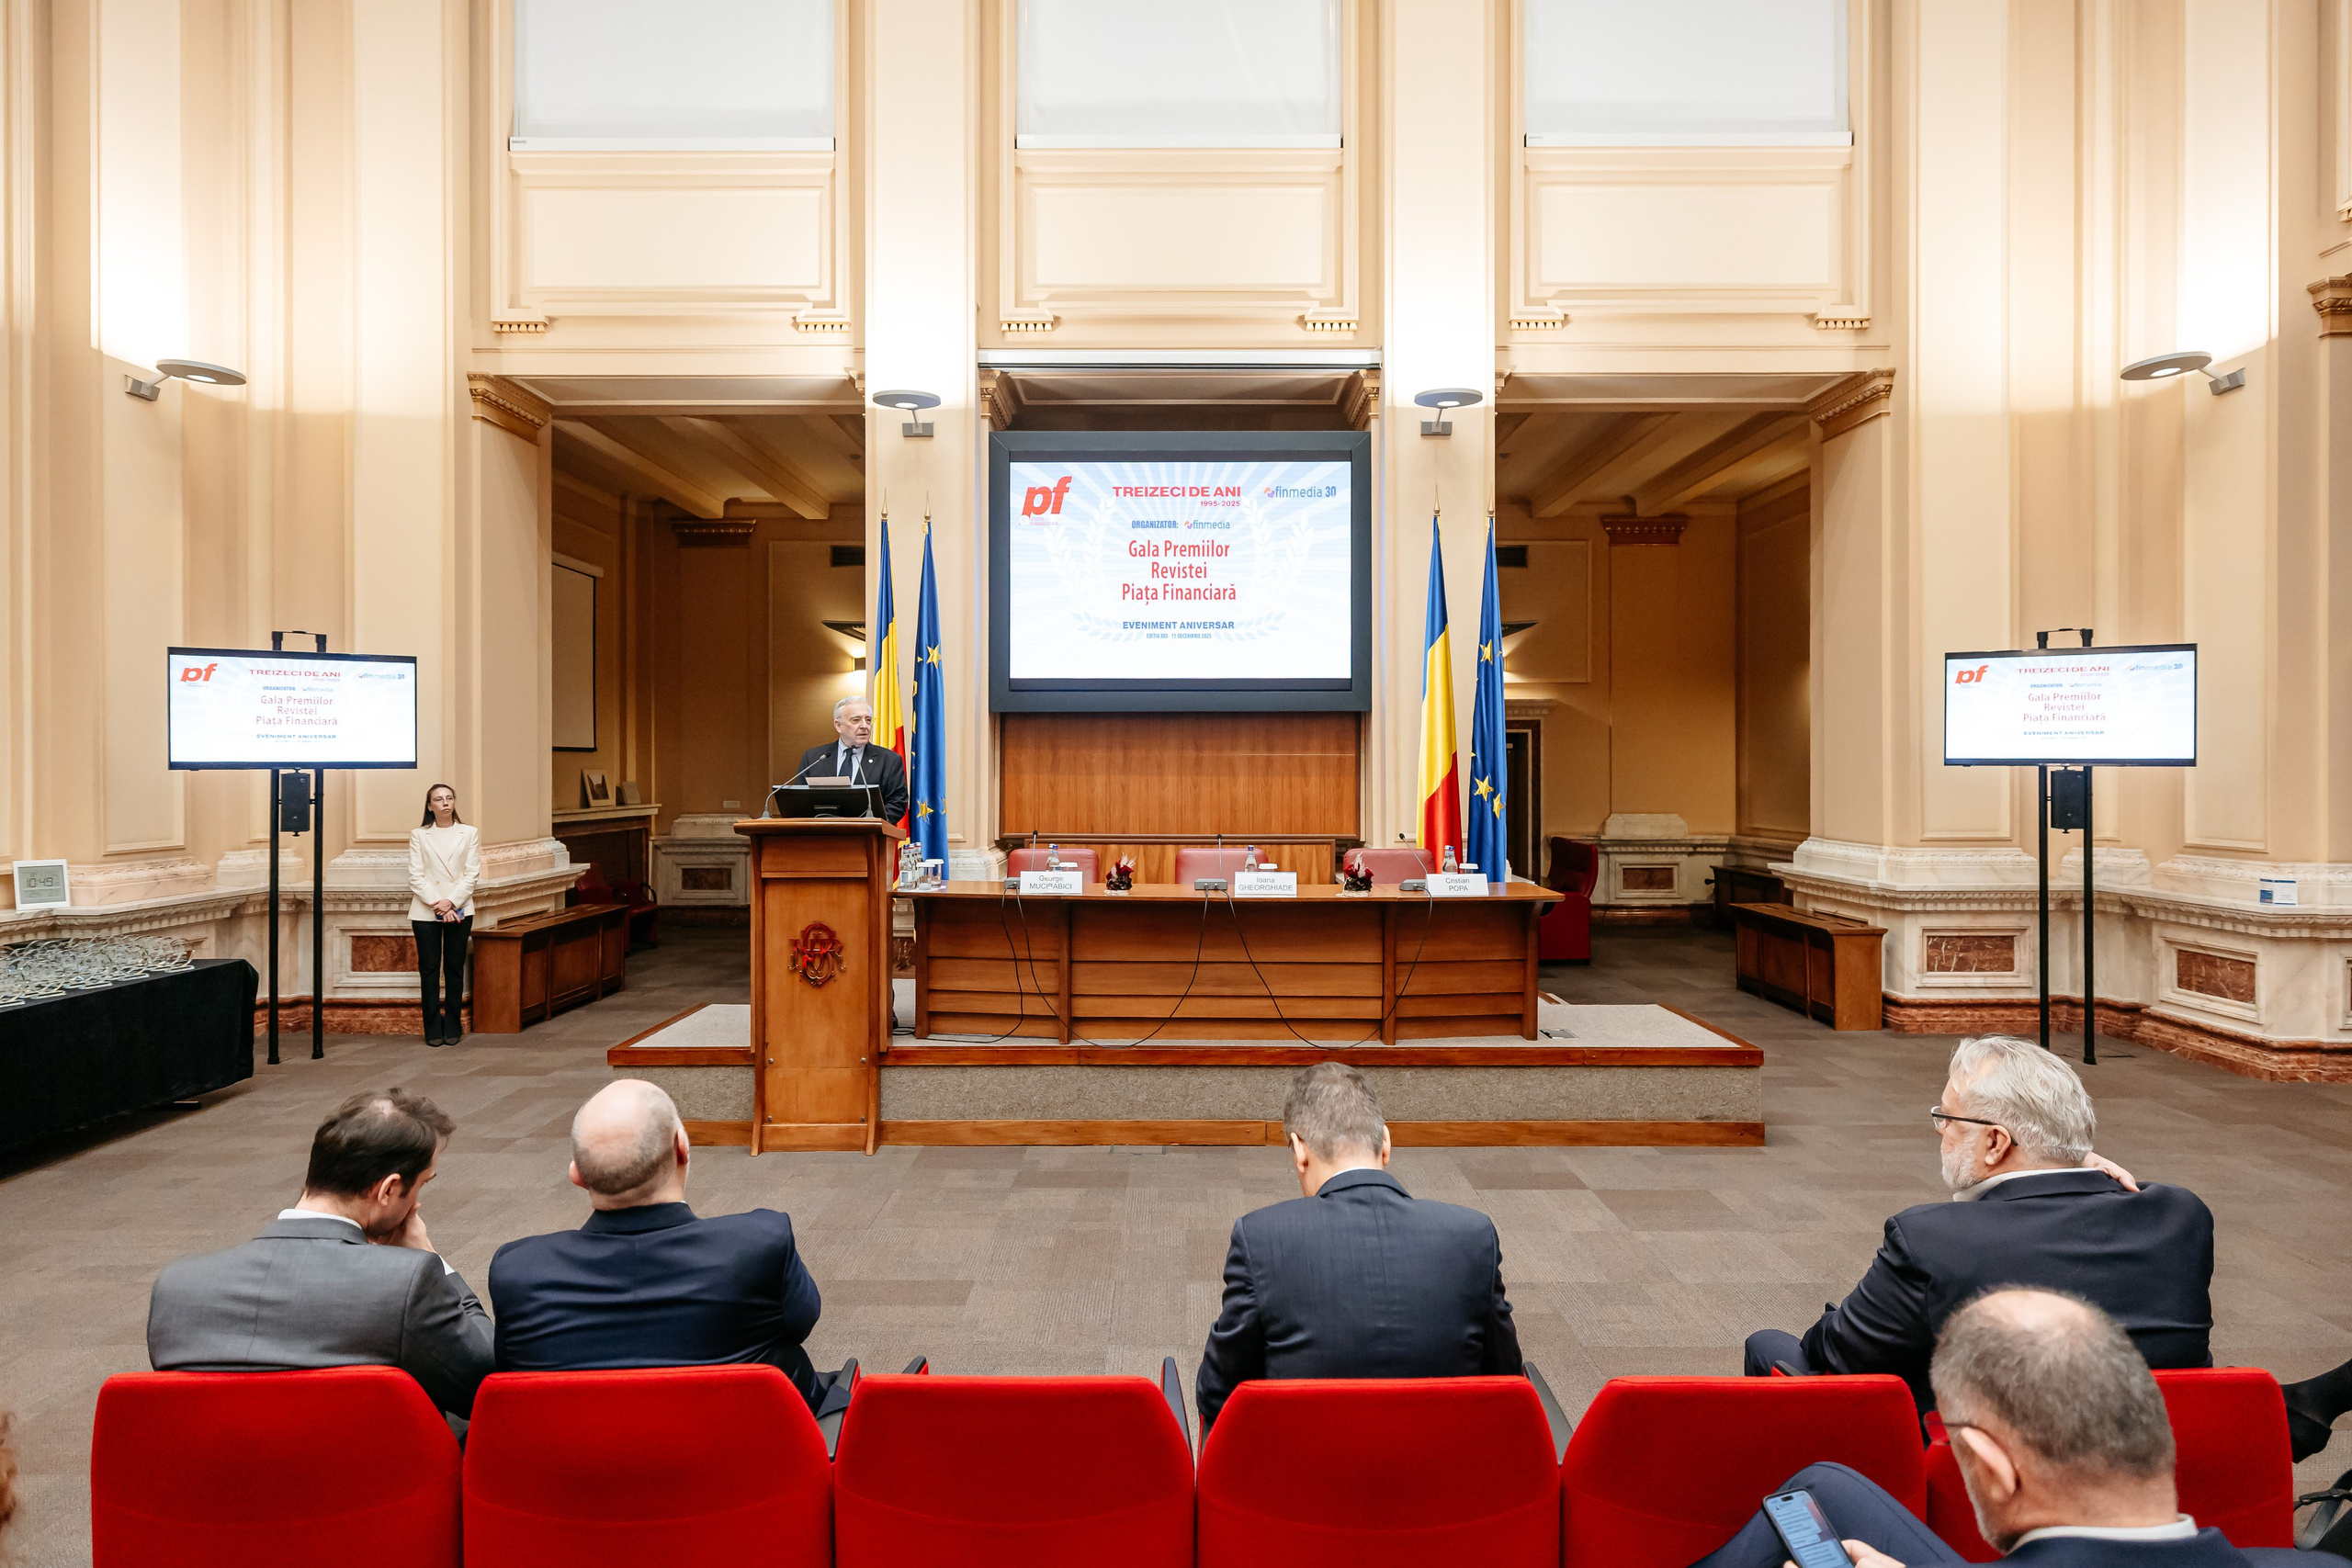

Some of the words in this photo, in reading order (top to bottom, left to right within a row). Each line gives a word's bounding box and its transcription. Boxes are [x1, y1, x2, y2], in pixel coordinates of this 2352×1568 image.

[1022, 476, 1072, 518] pf
[1113, 487, 1185, 497] TREIZECI
[1189, 487, 1210, 497] DE
[1214, 487, 1240, 497] ANI
[1275, 486, 1323, 498] finmedia
[1325, 486, 1336, 498] 30
[1131, 521, 1179, 529] ORGANIZATOR:
[1193, 520, 1230, 529] finmedia
[1128, 539, 1159, 558] Gala
[1164, 539, 1229, 558] Premiilor
[1151, 561, 1207, 579] Revistei
[1122, 583, 1159, 605] Piața
[1163, 583, 1236, 601] Financiară
[1123, 621, 1178, 629] EVENIMENT
[1180, 621, 1235, 629] ANIVERSAR
[180, 663, 218, 682] pf
[1955, 665, 1989, 684] pf
[260, 695, 283, 705] Gala
[286, 695, 334, 705] Premiilor
[2028, 693, 2050, 702] Gala
[2052, 692, 2101, 701] Premiilor
[277, 705, 317, 715] Revistei
[2044, 703, 2085, 711] Revistei
